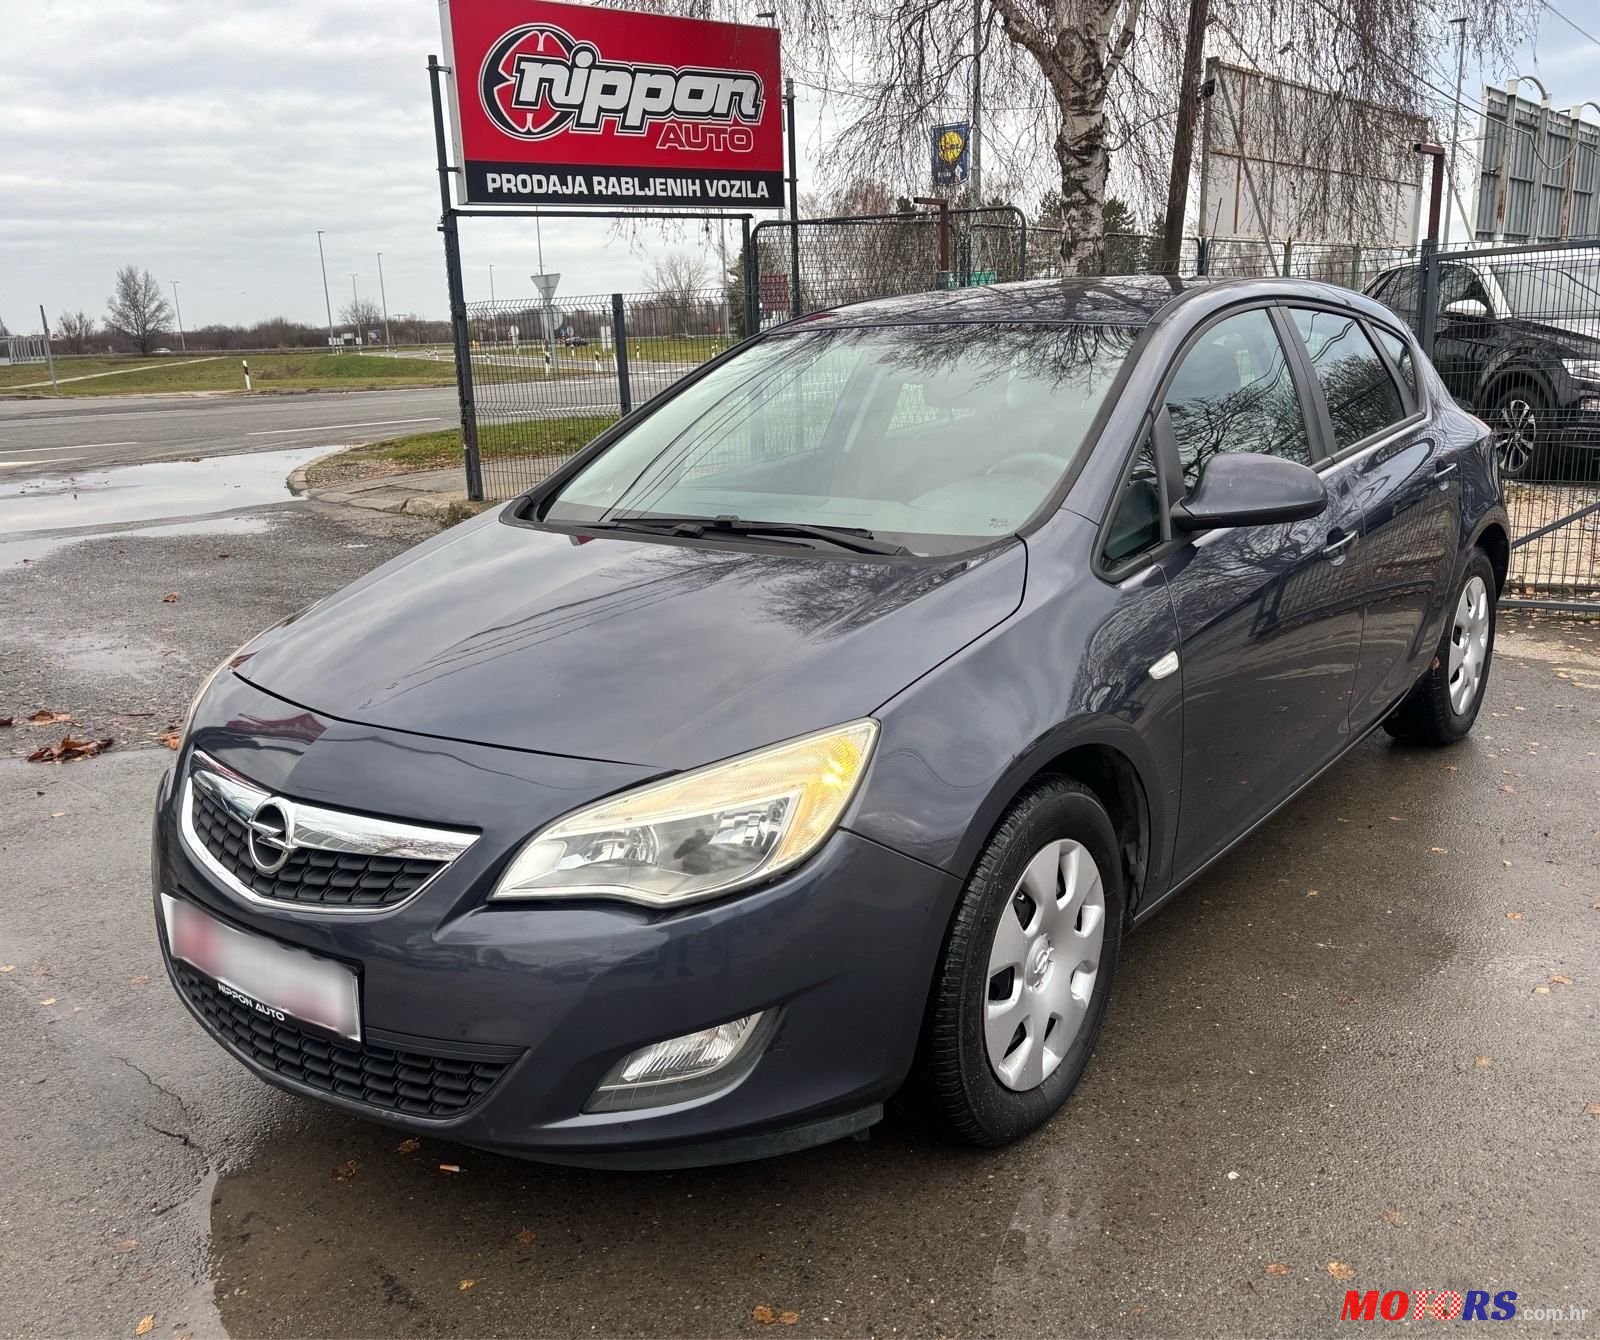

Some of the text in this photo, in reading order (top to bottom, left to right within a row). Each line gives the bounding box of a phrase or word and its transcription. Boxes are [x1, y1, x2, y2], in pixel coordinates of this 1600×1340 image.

[514, 45, 763, 131] nippon
[656, 123, 754, 152] AUTO
[486, 173, 769, 198] PRODAJA RABLJENIH VOZILA
[217, 982, 285, 1021] NIPPON AUTO
